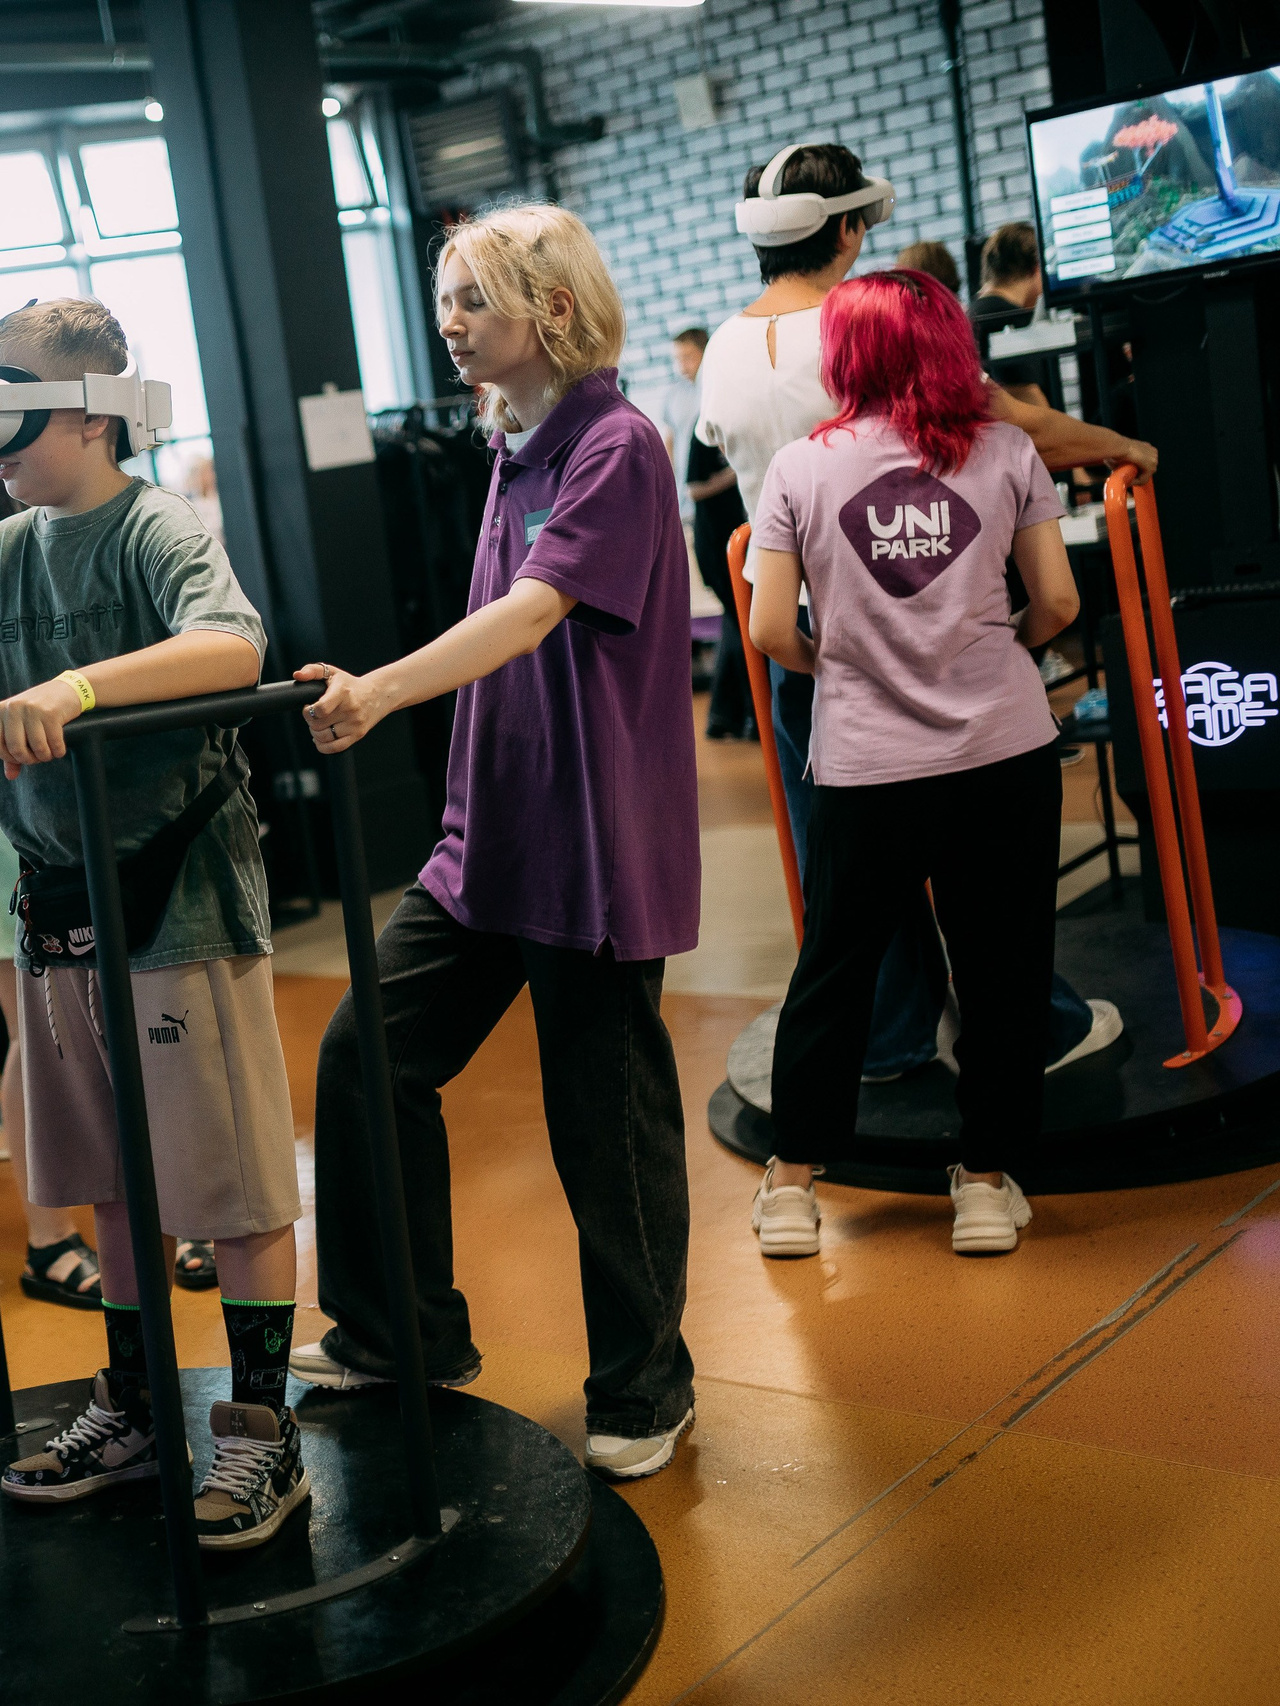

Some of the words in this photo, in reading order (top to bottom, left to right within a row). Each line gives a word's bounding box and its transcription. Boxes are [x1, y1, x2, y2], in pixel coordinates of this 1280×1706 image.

[866, 500, 950, 539] UNI
[871, 535, 952, 560] PARK
[75, 679, 90, 701] PARK
[148, 1026, 180, 1044] PUMA
